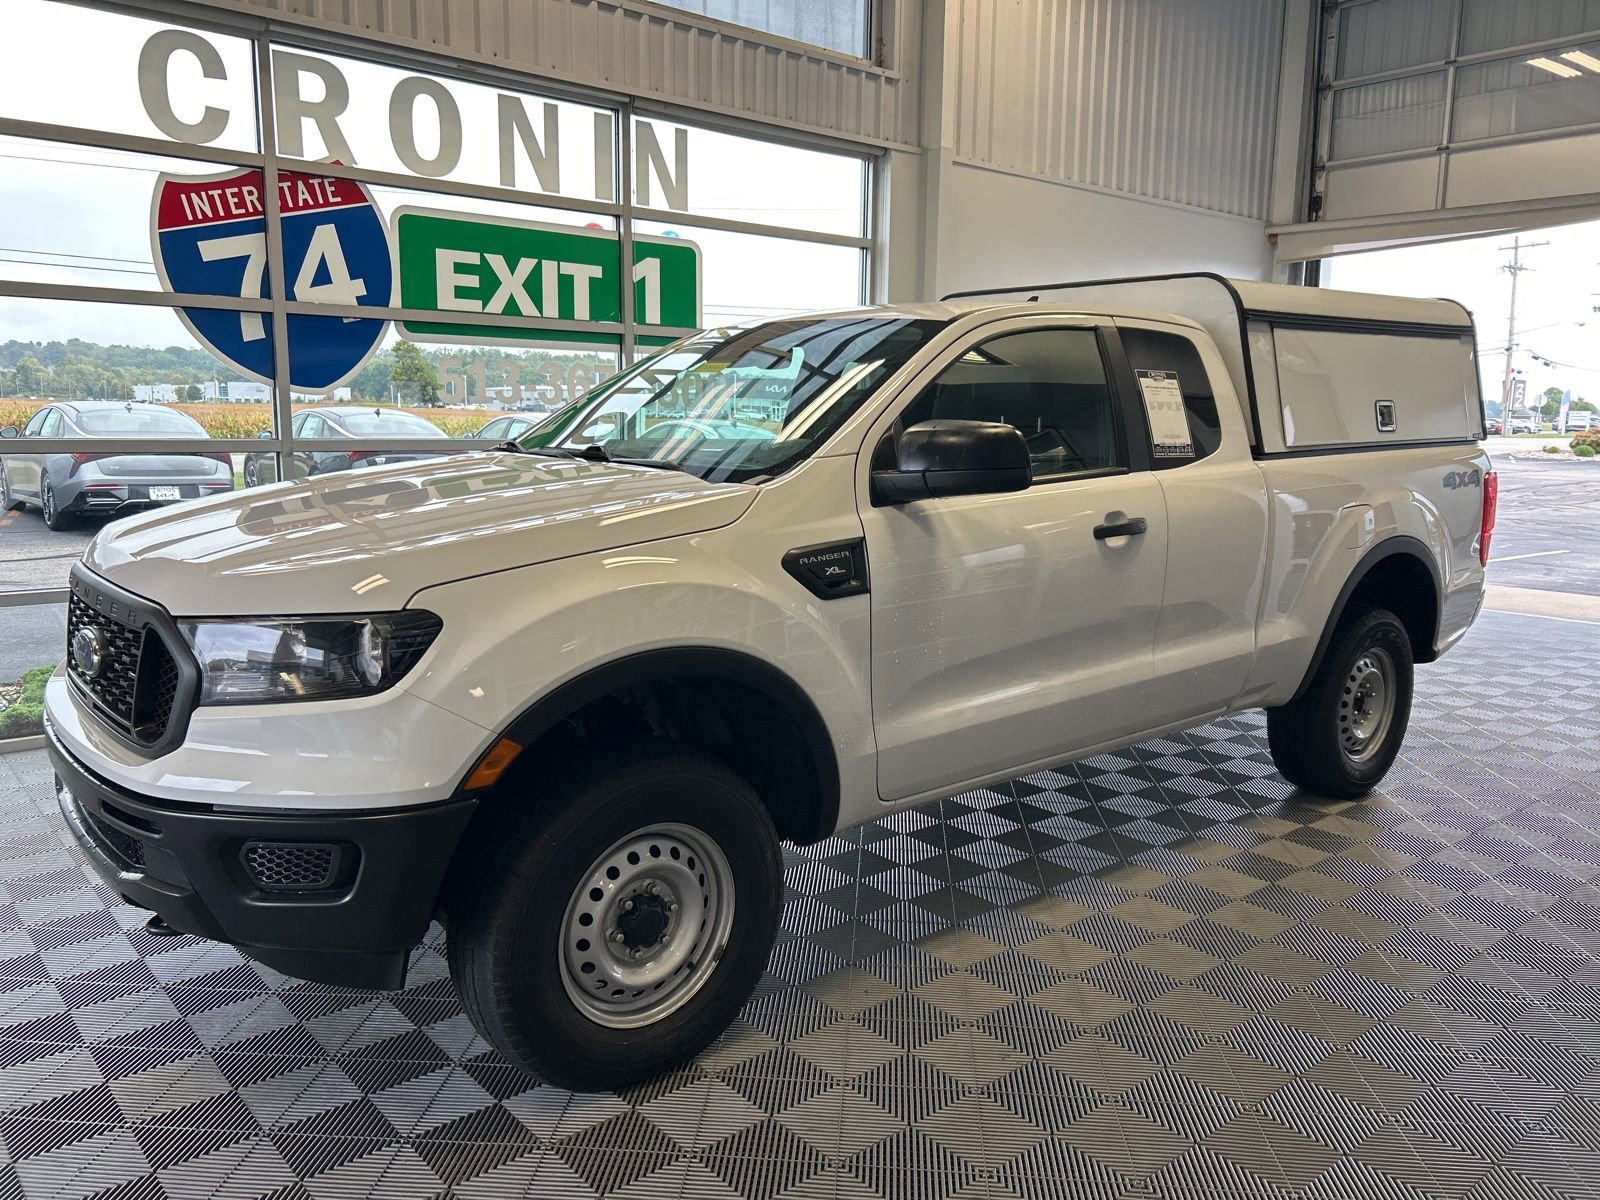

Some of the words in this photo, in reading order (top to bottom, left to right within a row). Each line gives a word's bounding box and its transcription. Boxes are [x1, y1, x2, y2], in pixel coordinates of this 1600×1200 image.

[137, 29, 689, 211] CRONIN
[180, 178, 342, 221] INTERTATE
[197, 223, 368, 342] 74
[435, 248, 602, 321] EXIT
[632, 257, 661, 325] 1
[799, 551, 850, 565] RANGER
[824, 566, 846, 576] XL
